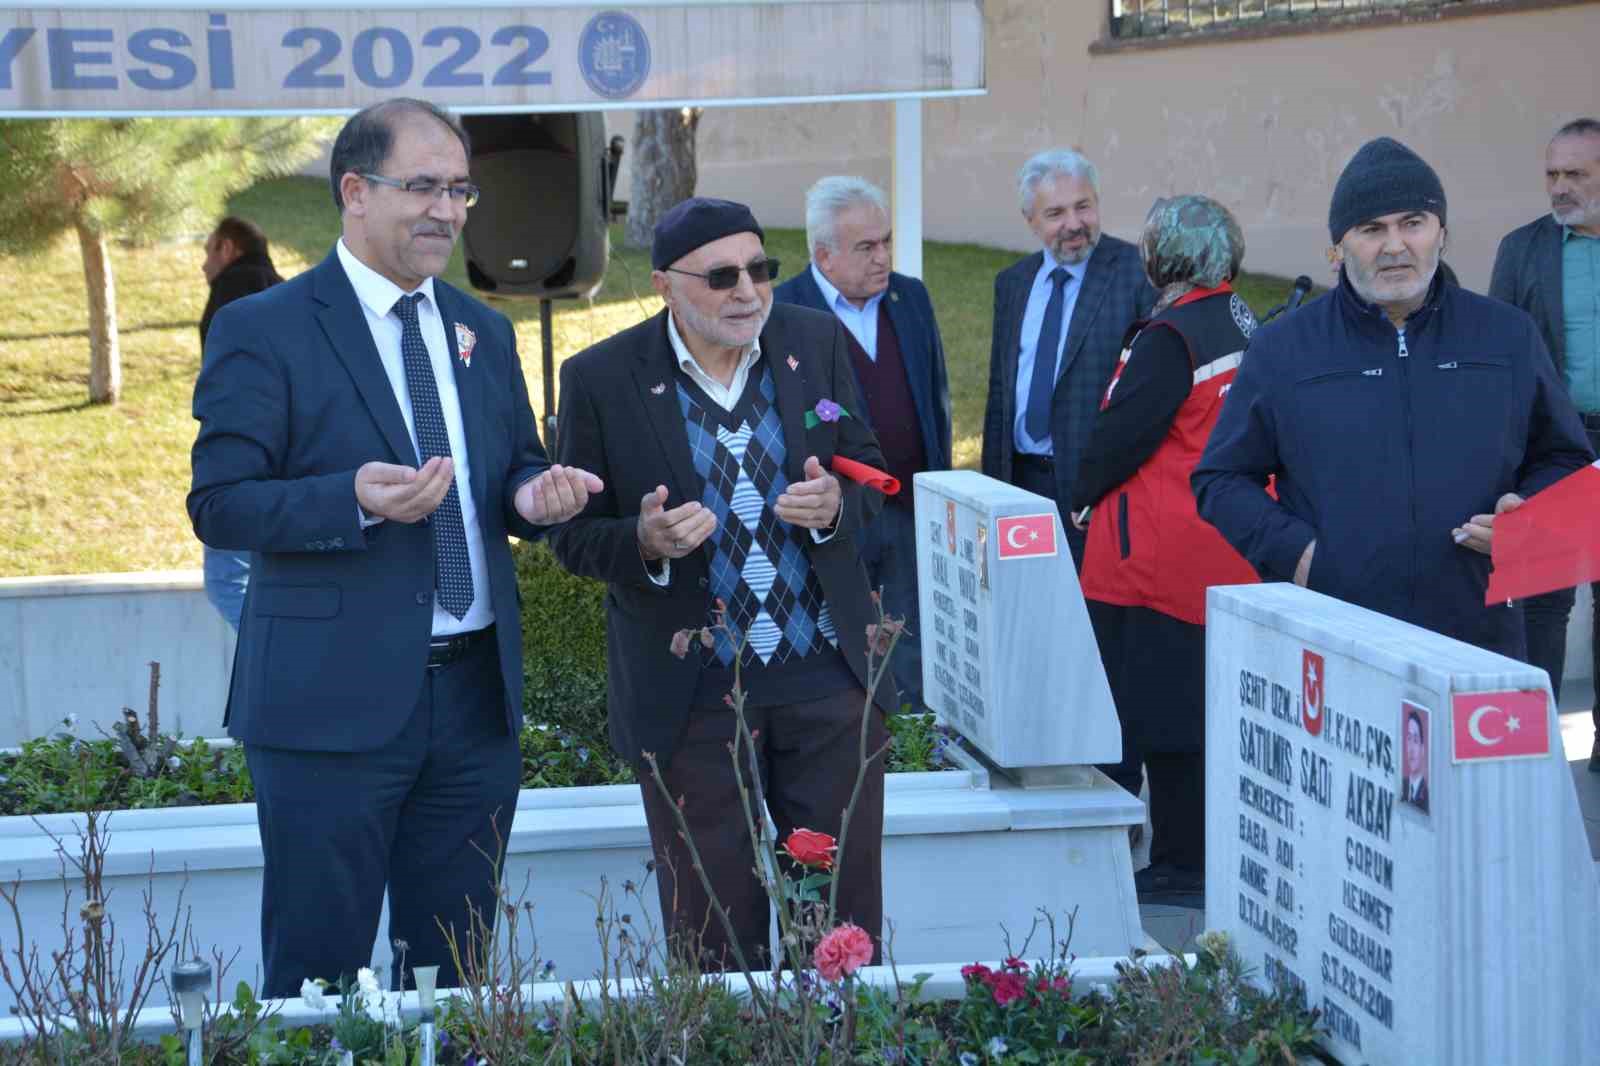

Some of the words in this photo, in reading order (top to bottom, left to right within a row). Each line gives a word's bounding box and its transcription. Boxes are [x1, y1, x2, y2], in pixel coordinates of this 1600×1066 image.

[281, 25, 552, 88] 2022
[1300, 746, 1333, 809] SADİ
[1346, 769, 1394, 842] AKBAY
[1239, 813, 1269, 857] BABA
[1275, 836, 1294, 872] ADI
[1343, 878, 1394, 936] MEHMET
[1346, 835, 1394, 892] ÇORUM
[1239, 853, 1269, 897] ANNE
[1275, 876, 1294, 913] ADI
[1328, 911, 1393, 984] GÜLBAHAR
